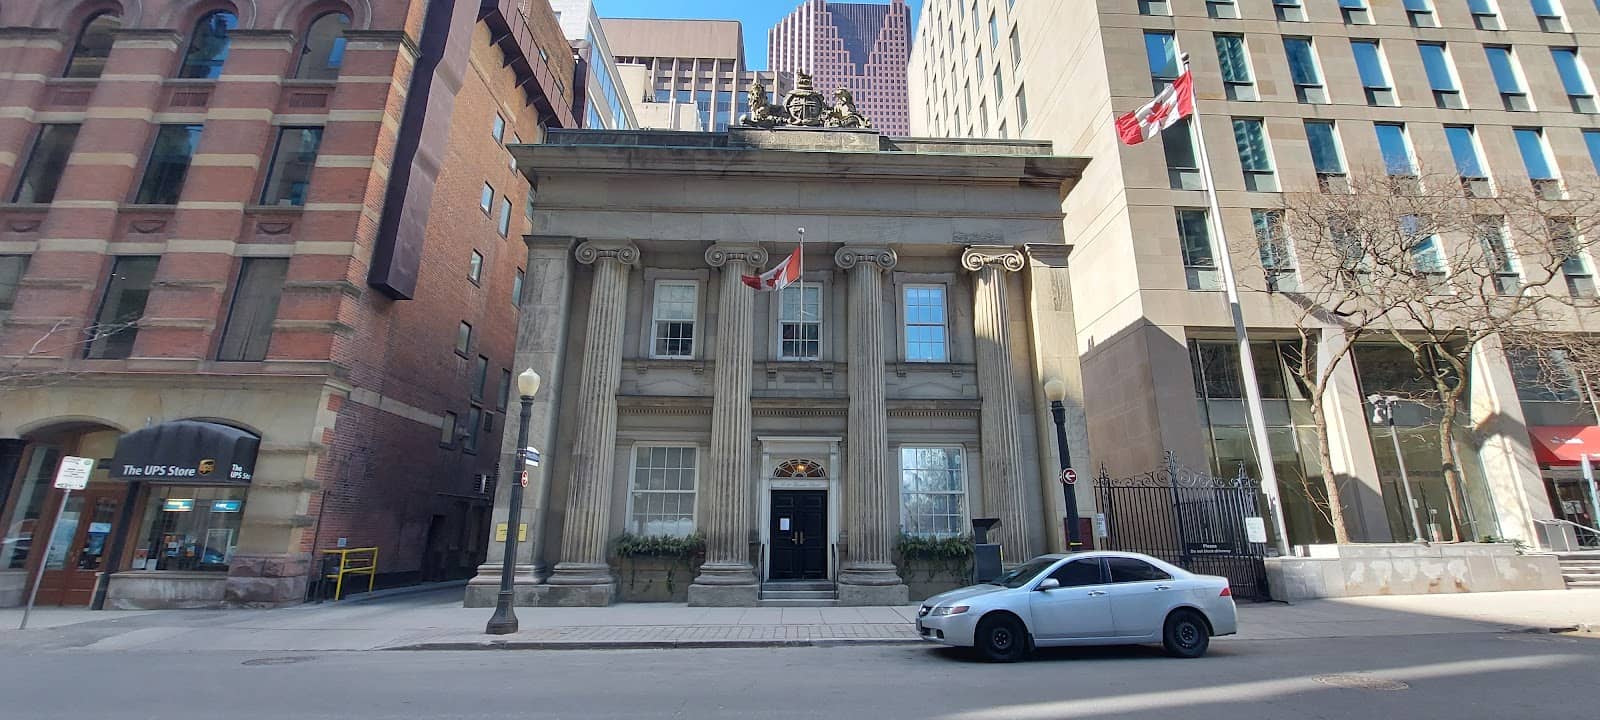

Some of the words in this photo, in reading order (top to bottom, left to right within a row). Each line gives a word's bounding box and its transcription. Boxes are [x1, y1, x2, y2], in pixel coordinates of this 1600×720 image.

[122, 465, 142, 475] The
[144, 465, 166, 476] UPS
[167, 465, 196, 476] Store
[232, 463, 243, 472] The
[230, 471, 242, 479] UPS
